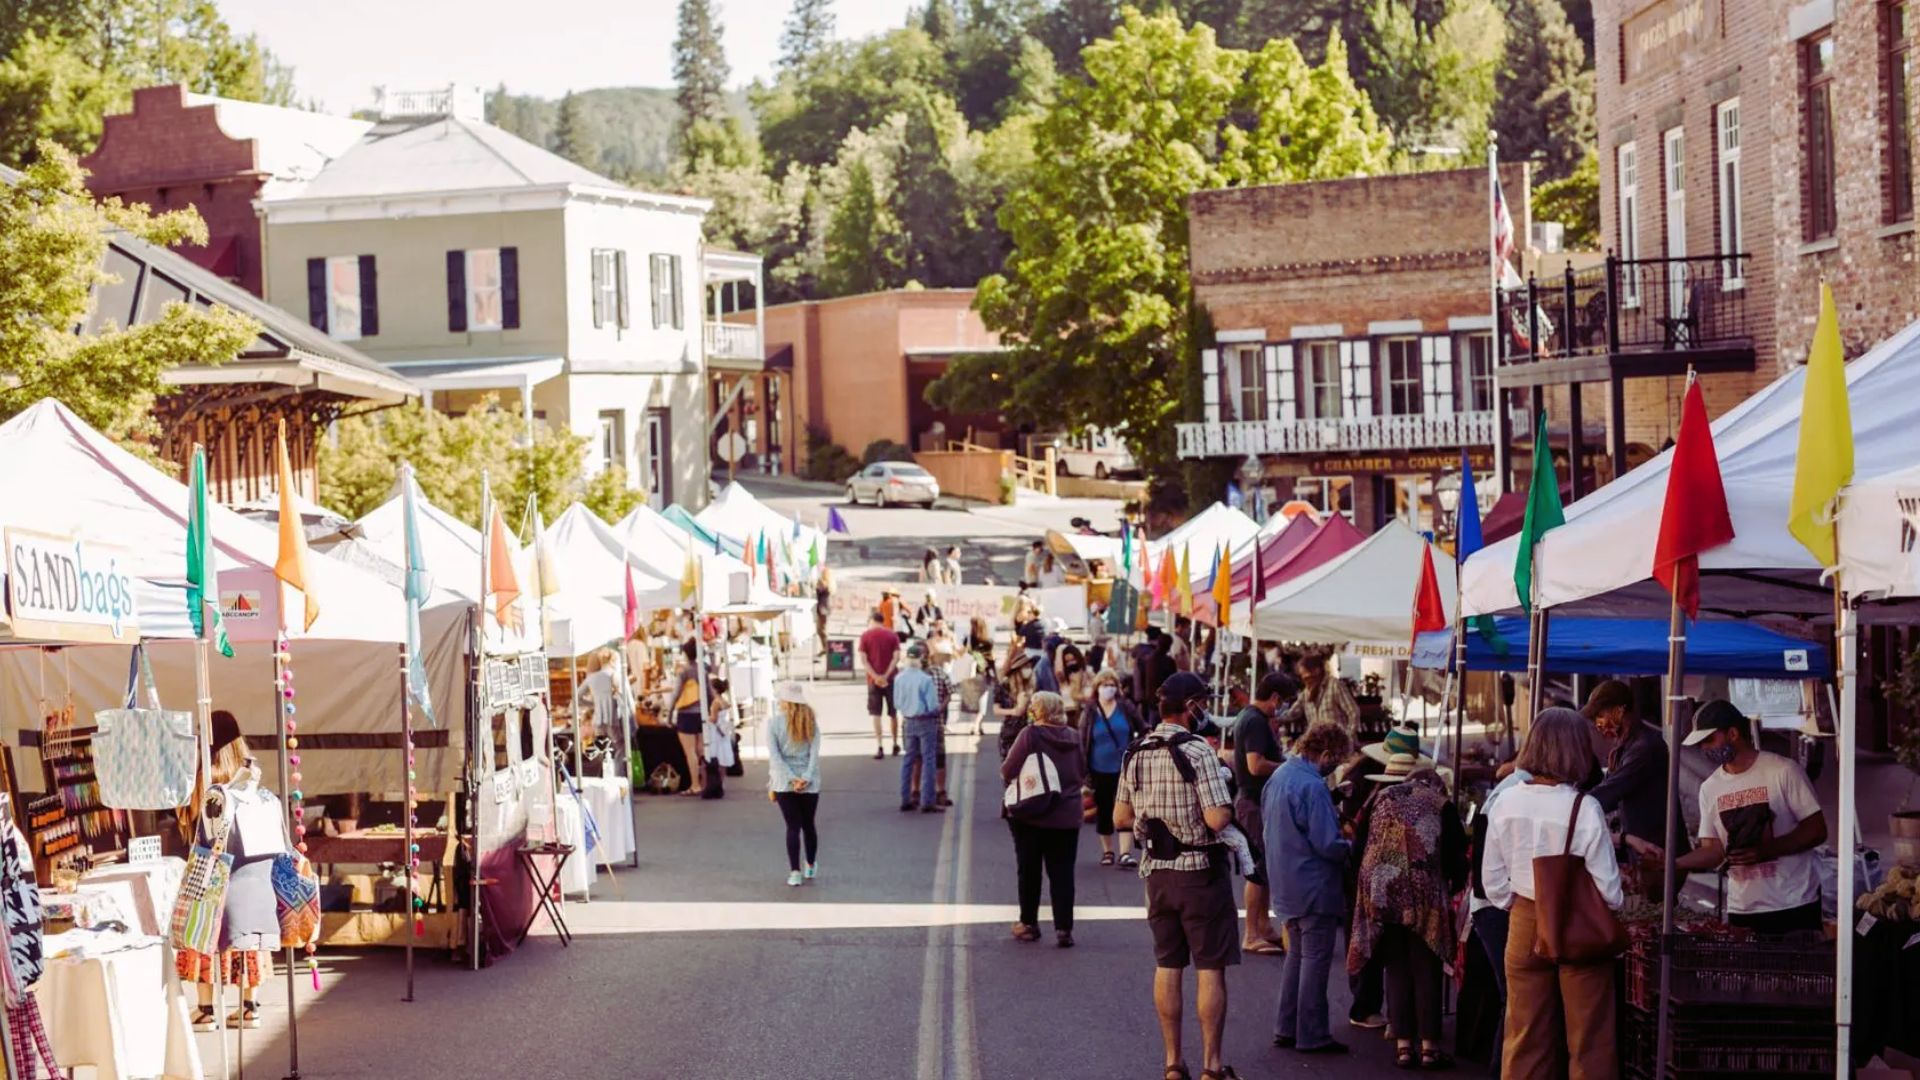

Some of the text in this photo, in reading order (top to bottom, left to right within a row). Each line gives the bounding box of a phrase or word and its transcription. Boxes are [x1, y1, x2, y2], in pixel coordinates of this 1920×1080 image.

[1324, 459, 1391, 471] CHAMBER
[1408, 455, 1485, 469] COMMECE
[1354, 645, 1393, 656] FRESH
